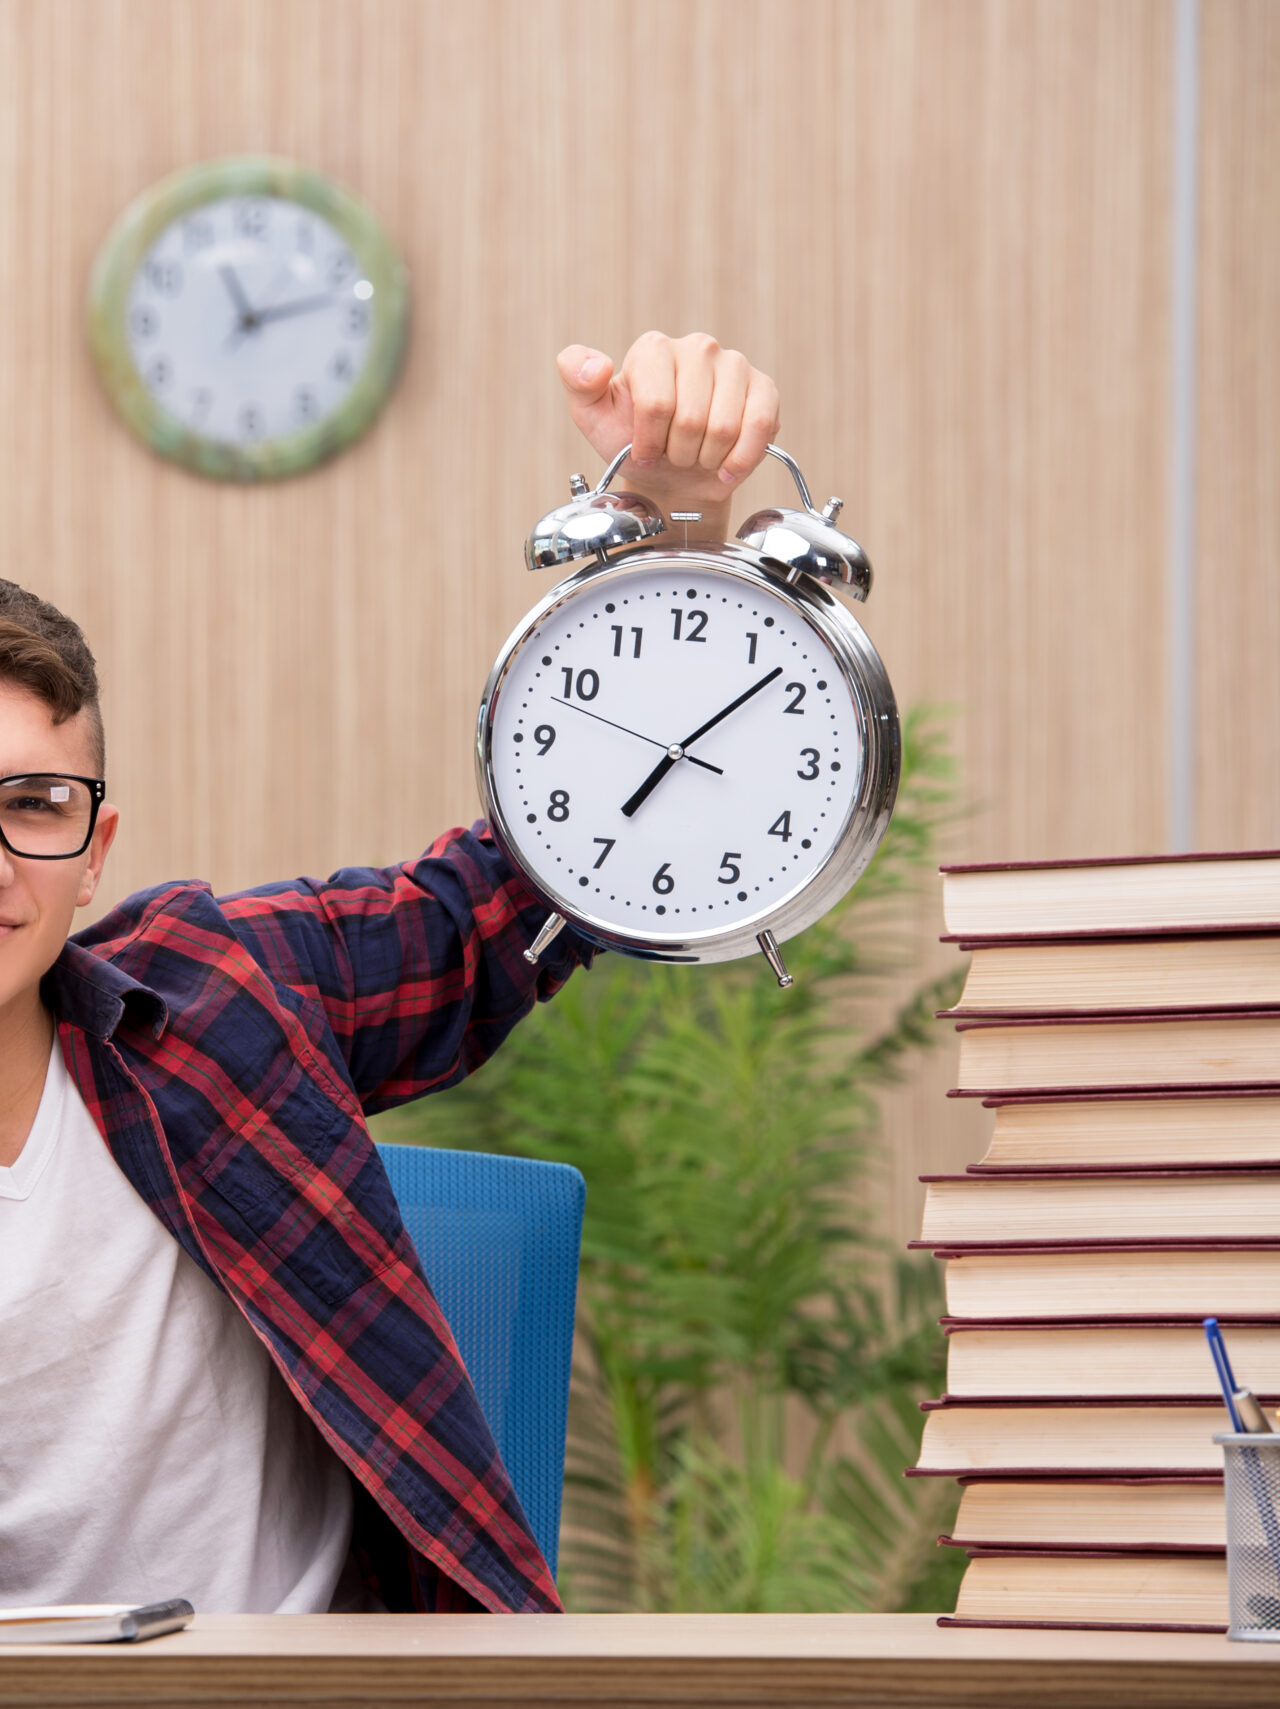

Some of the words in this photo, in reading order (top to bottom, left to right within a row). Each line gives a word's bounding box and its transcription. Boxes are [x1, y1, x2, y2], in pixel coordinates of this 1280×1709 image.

[610, 624, 643, 659] 11
[670, 608, 709, 643] 12
[745, 632, 758, 665] 1
[561, 666, 600, 702] 10
[783, 681, 807, 715] 2
[533, 724, 557, 756] 9
[796, 747, 821, 781] 3
[546, 789, 570, 823] 8
[767, 810, 793, 843] 4
[592, 837, 617, 870] 7
[717, 851, 742, 885] 5
[652, 862, 675, 896] 6
